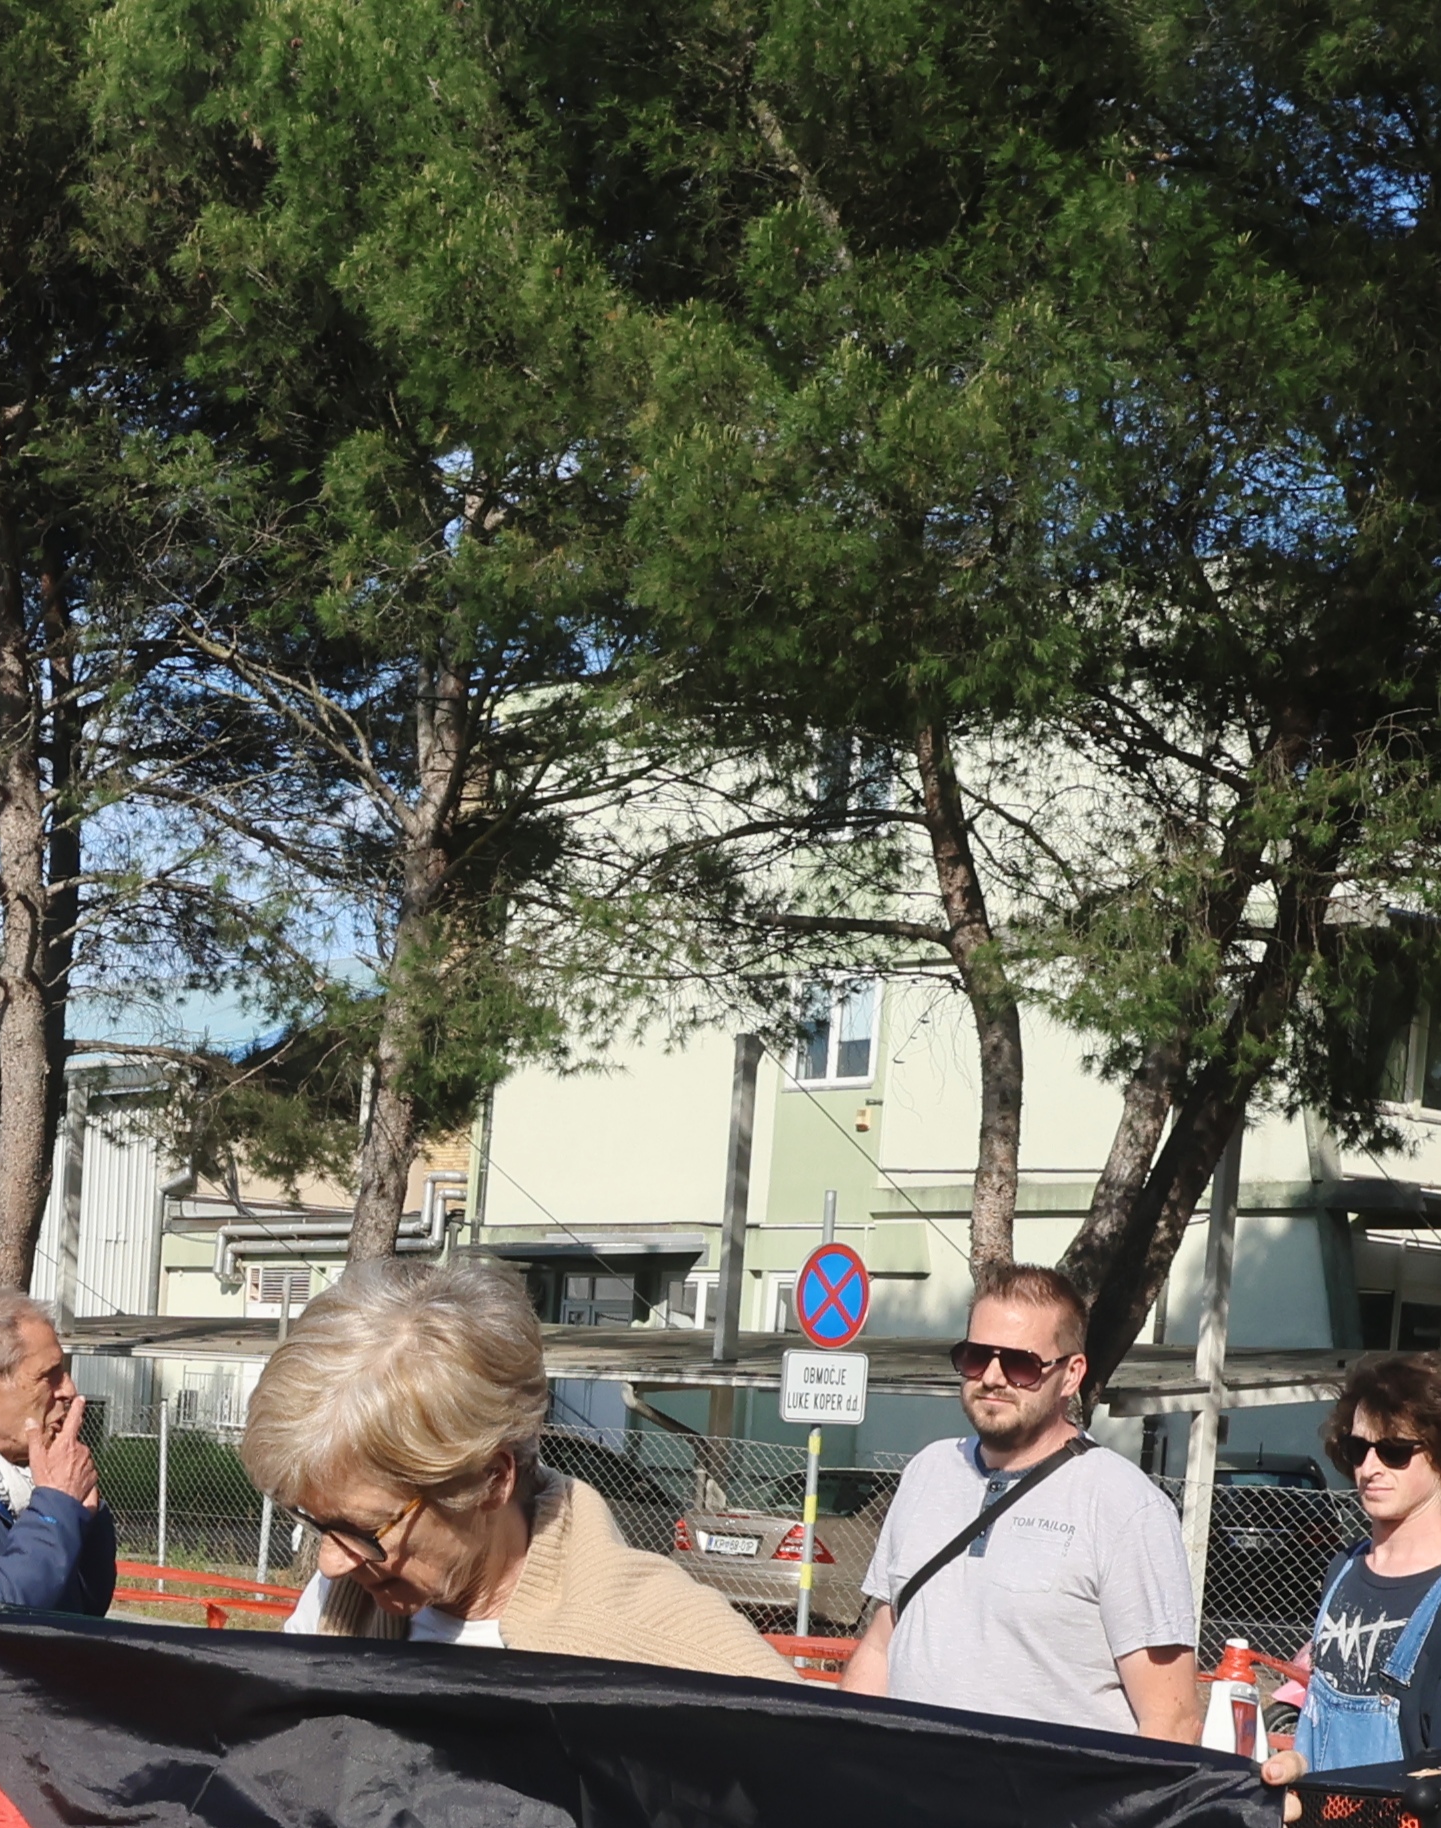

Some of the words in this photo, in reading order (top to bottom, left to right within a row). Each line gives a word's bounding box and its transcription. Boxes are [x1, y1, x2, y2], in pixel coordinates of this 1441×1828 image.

[803, 1364, 847, 1386] OBMOČJE
[787, 1391, 810, 1409] LUKE
[813, 1393, 843, 1411] KOPER
[1012, 1516, 1035, 1527] TOM
[1037, 1518, 1076, 1535] TAILOR
